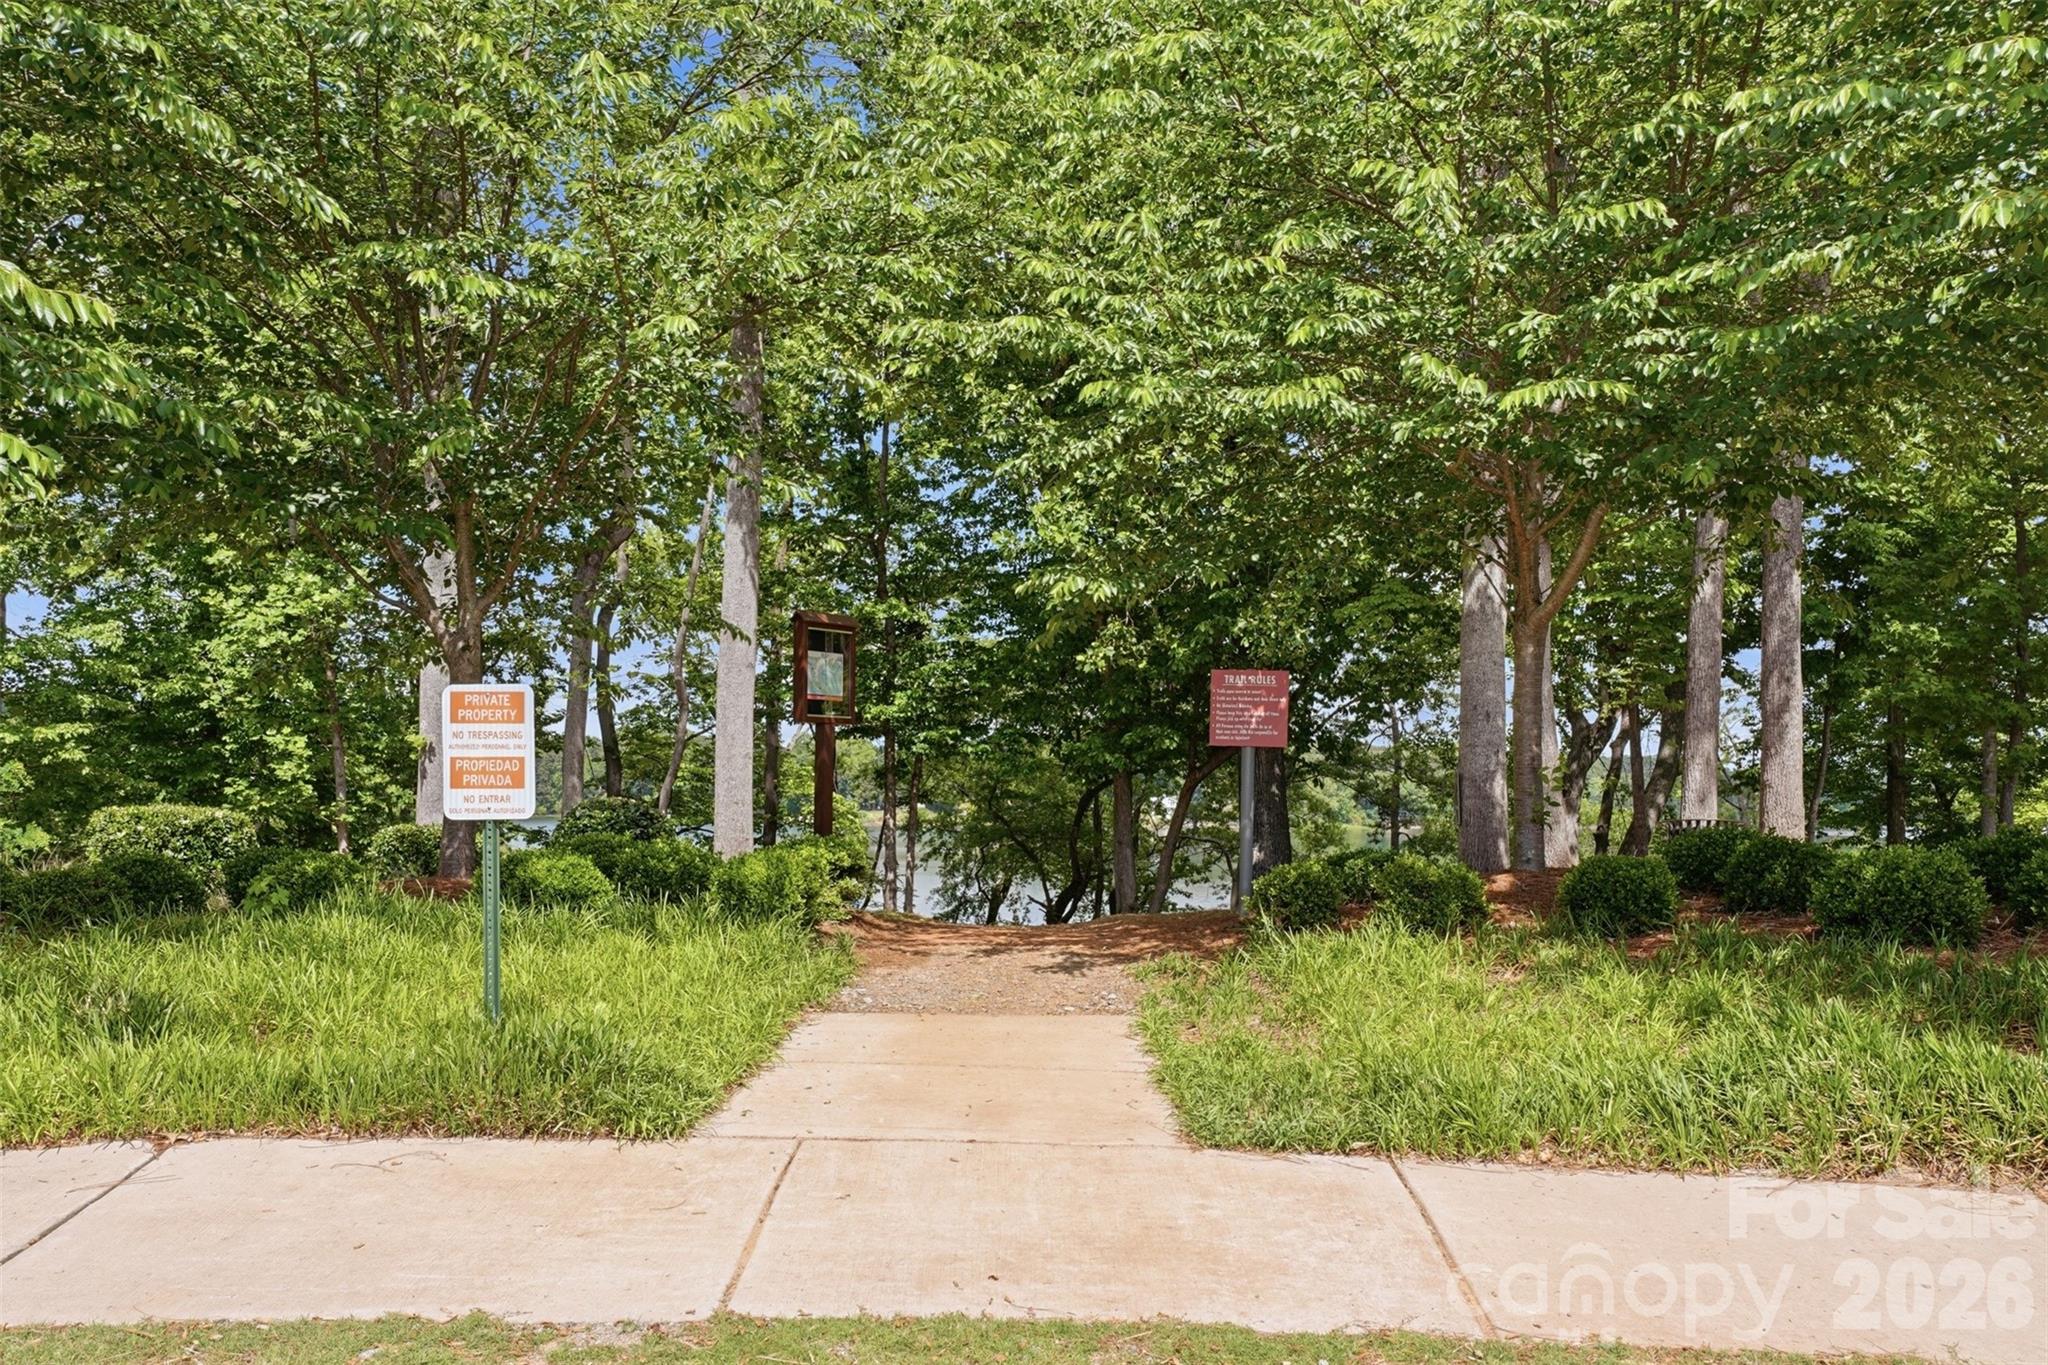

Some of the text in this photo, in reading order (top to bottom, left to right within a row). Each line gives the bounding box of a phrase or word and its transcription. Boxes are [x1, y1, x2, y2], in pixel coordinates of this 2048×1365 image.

[1224, 674, 1277, 685] TRAIL RULES
[464, 694, 511, 706] PRIVATE
[457, 709, 517, 721] PROPERTY
[452, 730, 523, 740] NO TRESPASSING
[455, 759, 520, 772] PROPIEDAD
[463, 774, 512, 786] PRIVADA
[463, 794, 511, 804] NO ENTRAR
